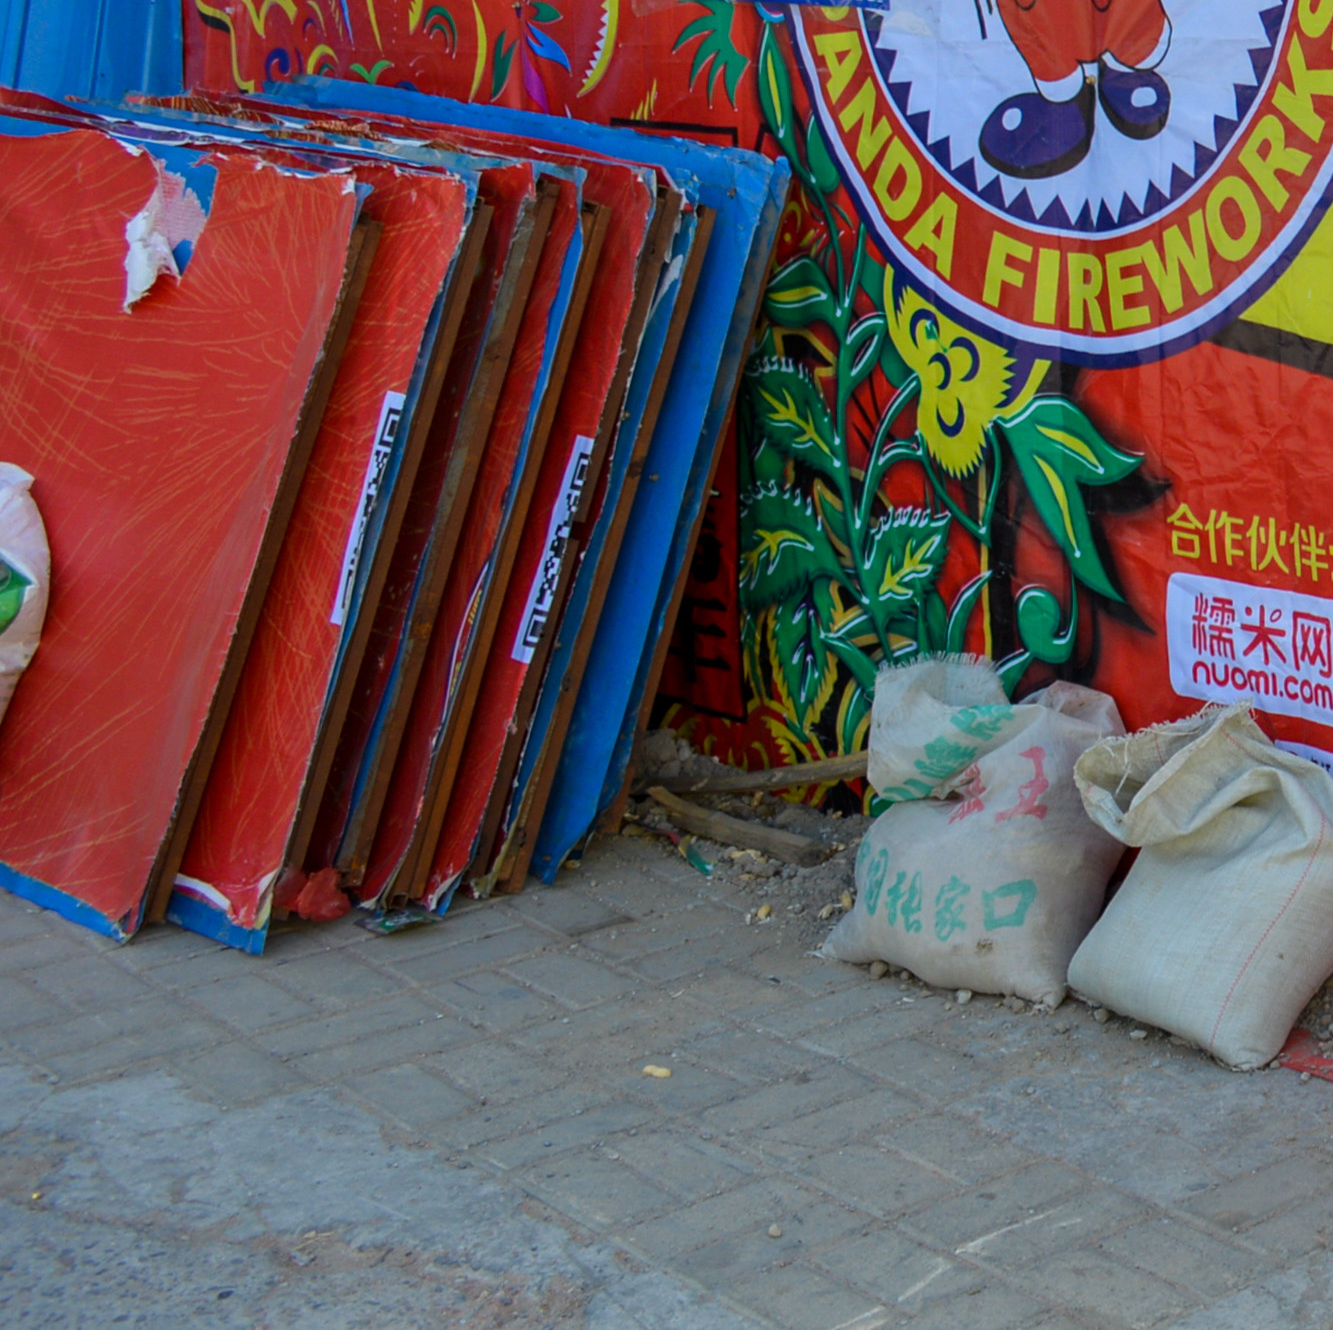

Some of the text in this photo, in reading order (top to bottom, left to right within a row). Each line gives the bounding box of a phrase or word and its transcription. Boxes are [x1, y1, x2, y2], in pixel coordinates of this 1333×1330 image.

[800, 3, 960, 283] ANDA
[1191, 591, 1333, 679] 糯米网
